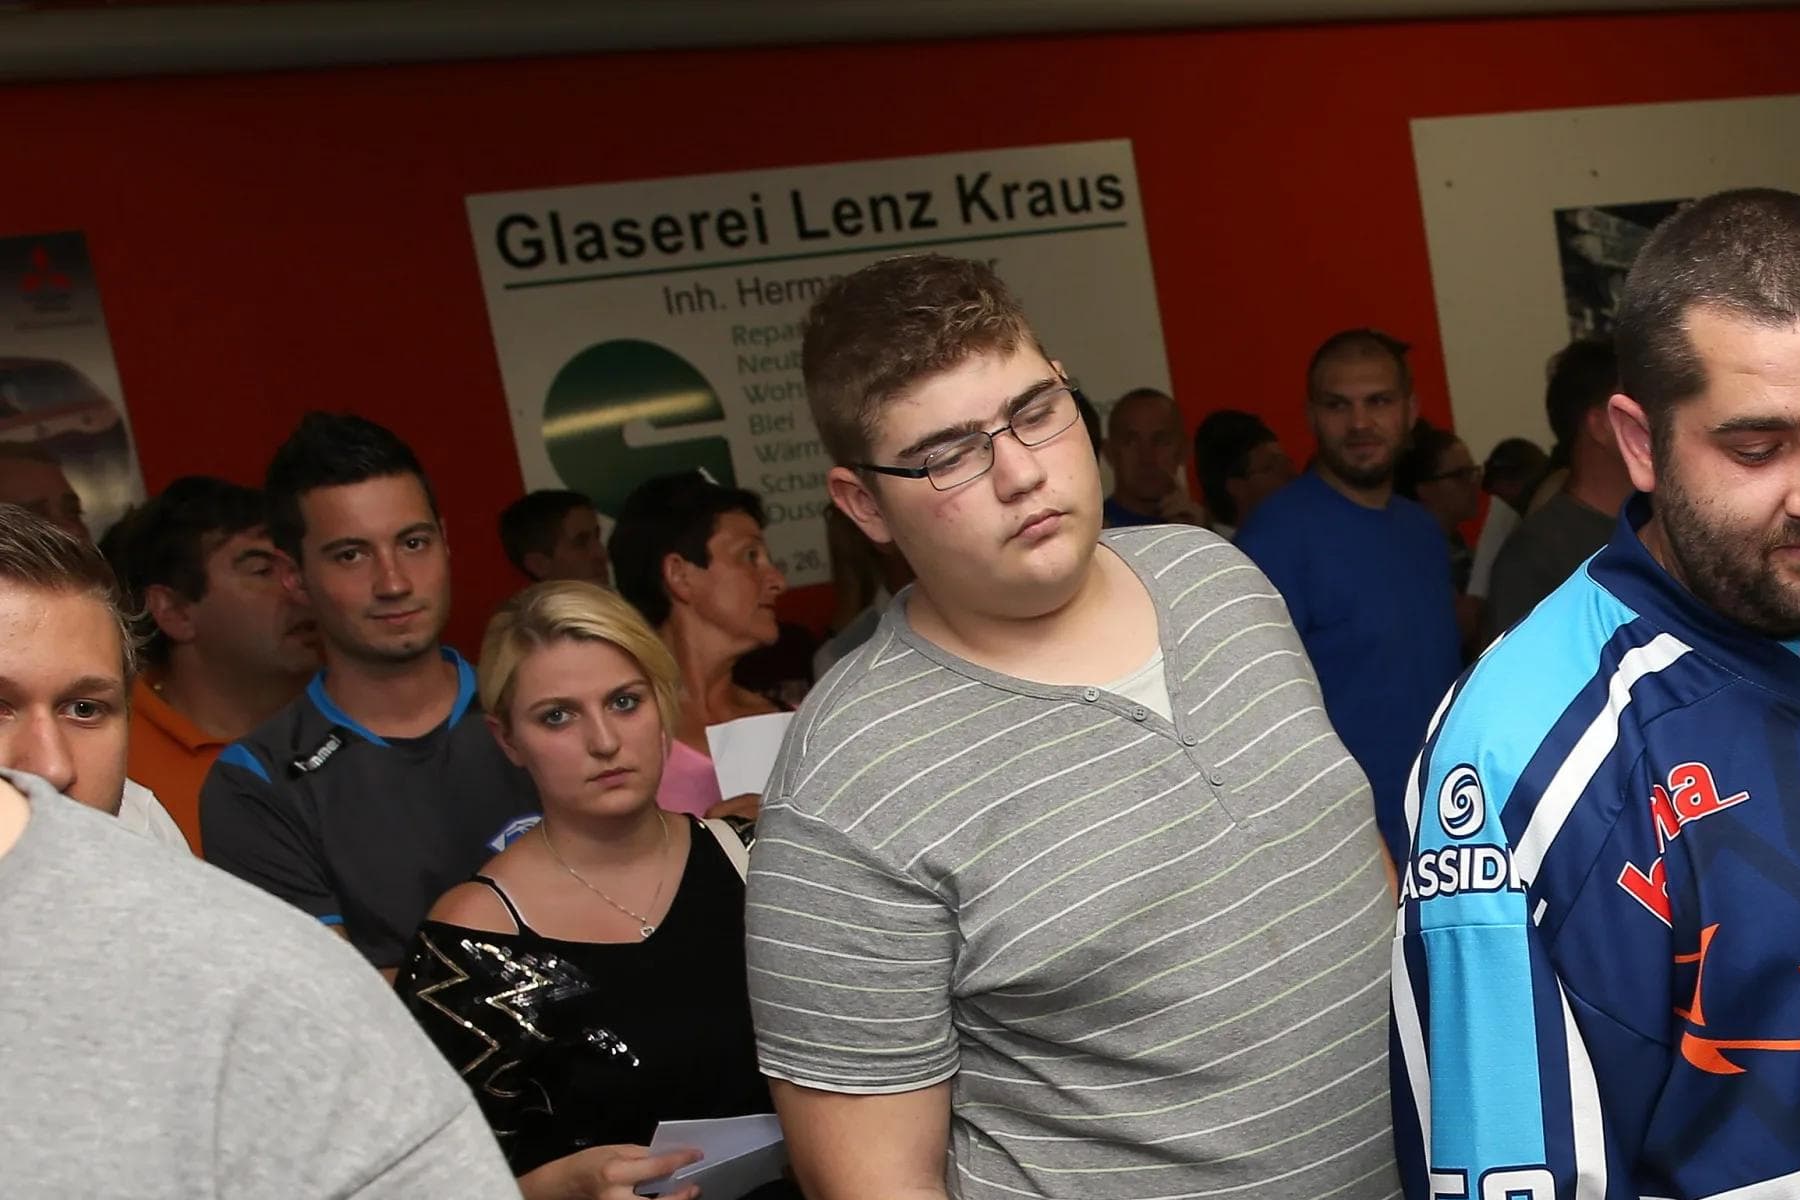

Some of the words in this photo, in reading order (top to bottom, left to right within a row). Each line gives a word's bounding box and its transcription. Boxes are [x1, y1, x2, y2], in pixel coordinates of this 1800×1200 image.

[496, 192, 769, 269] Glaserei
[790, 189, 938, 241] Lenz
[955, 171, 1125, 225] Kraus
[663, 281, 727, 316] Inh.
